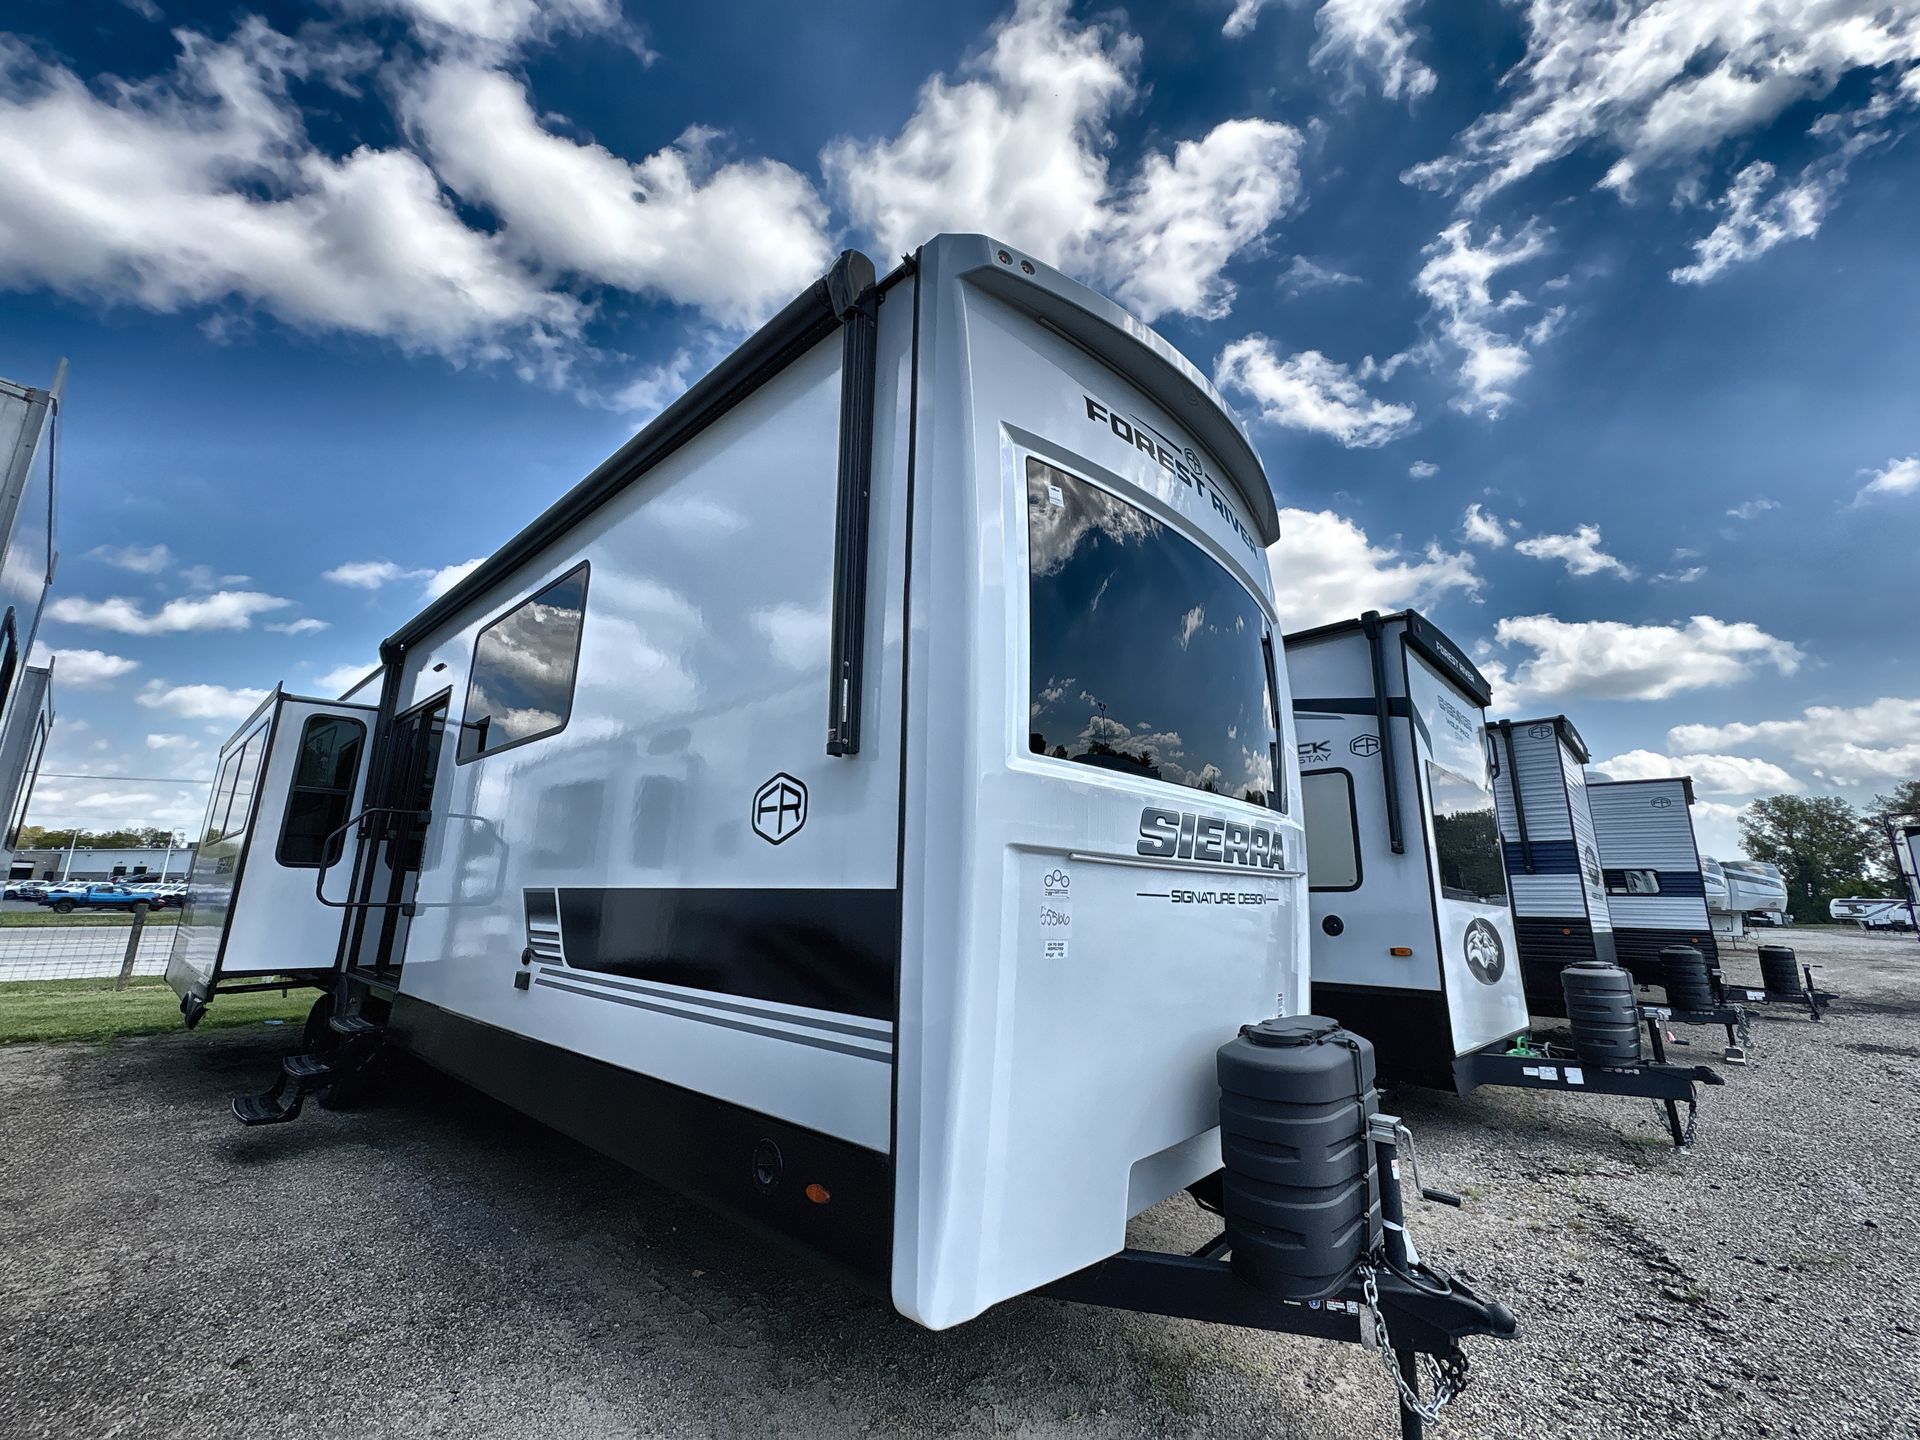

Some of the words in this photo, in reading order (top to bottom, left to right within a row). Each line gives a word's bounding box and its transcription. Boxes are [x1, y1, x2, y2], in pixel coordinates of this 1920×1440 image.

[1082, 394, 1205, 498] FOREST
[1208, 488, 1258, 561] RIVER
[1297, 740, 1331, 755] CK
[1298, 752, 1331, 764] STAY
[755, 780, 803, 836] FR
[1136, 806, 1285, 870] SIERRA
[1170, 889, 1236, 904] SIGNATURE
